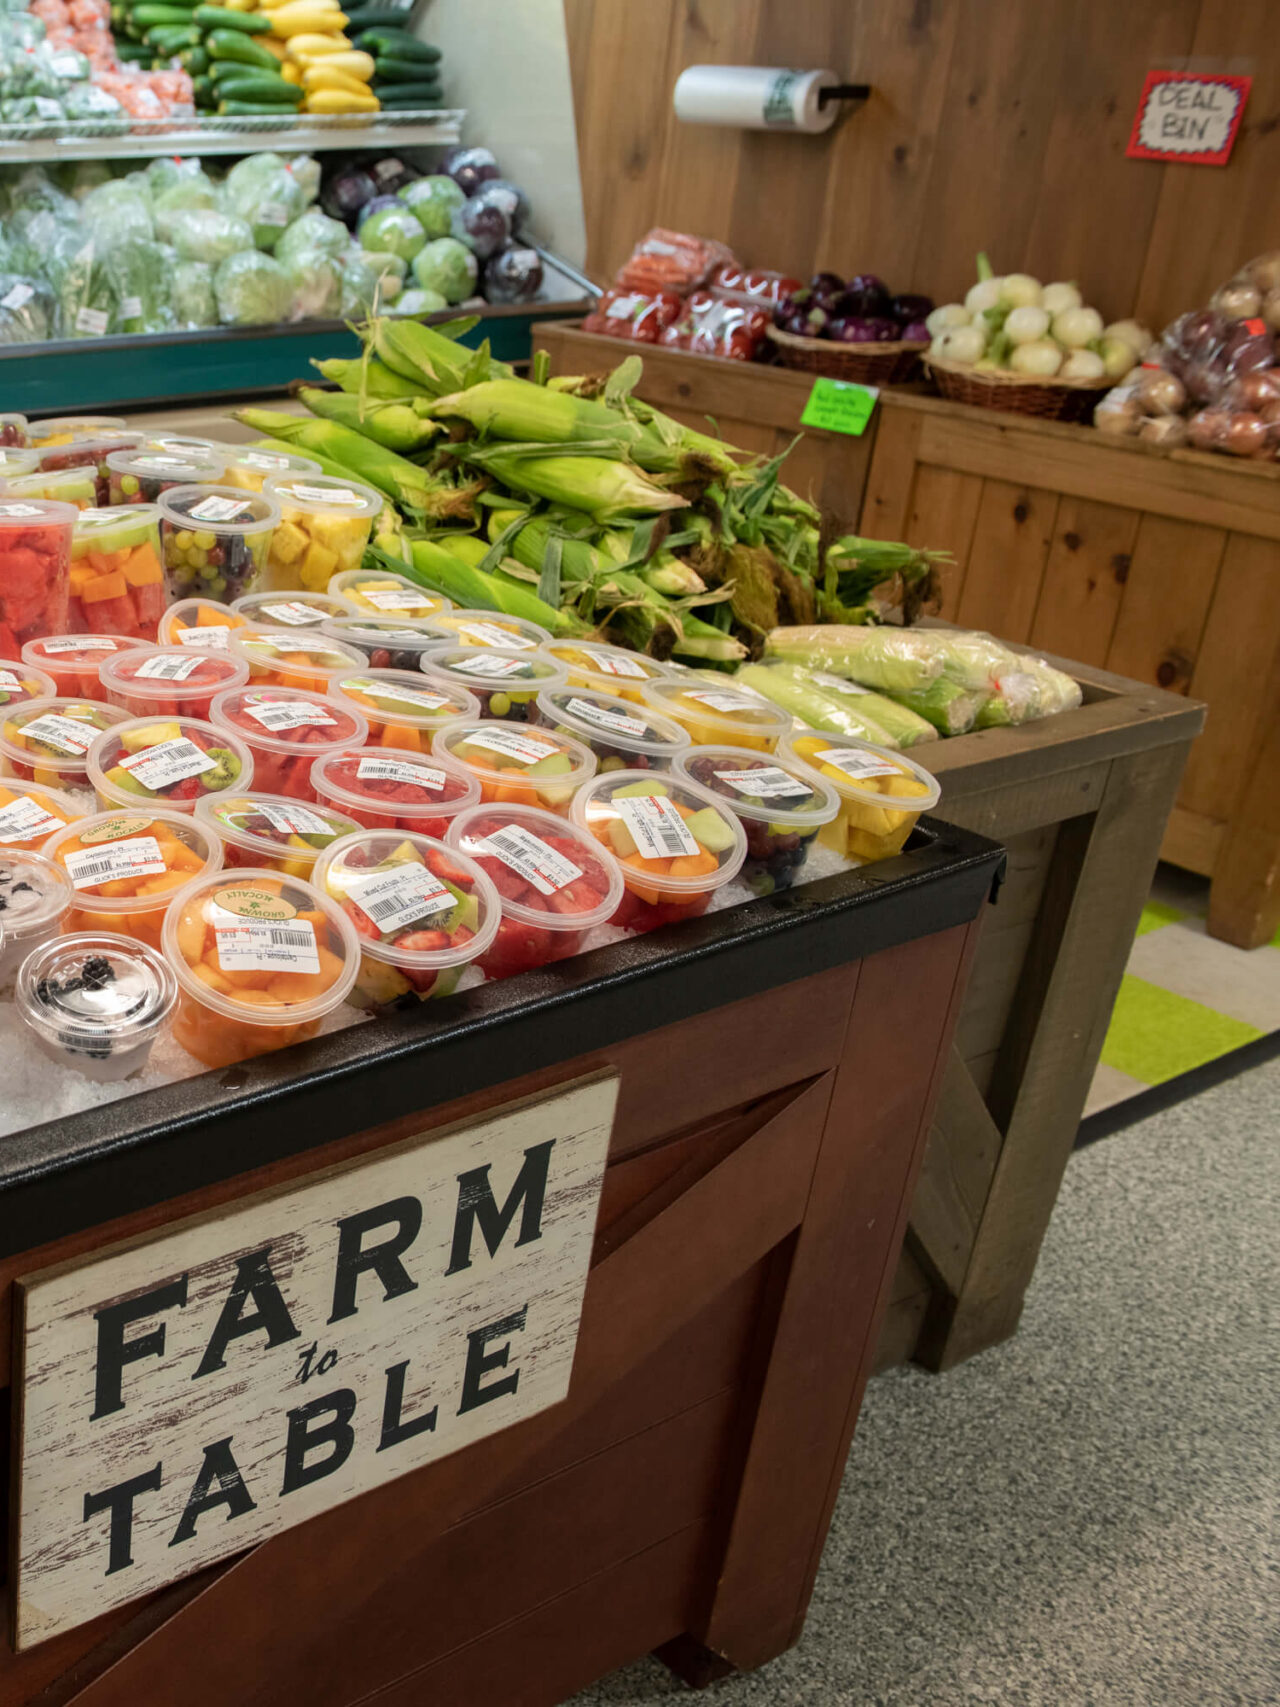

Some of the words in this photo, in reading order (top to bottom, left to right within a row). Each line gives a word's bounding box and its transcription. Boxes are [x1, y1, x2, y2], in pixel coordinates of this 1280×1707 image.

[1158, 86, 1222, 111] DEAL
[1161, 113, 1210, 140] BIN
[87, 819, 123, 837] GROWN
[114, 822, 145, 838] LOCALLY
[117, 867, 144, 878] PRODUCE
[226, 891, 267, 900] LOCALLY
[246, 908, 286, 918] GROWN
[413, 900, 442, 917] PRODUCE
[267, 952, 298, 962] Cantaloupe
[90, 1138, 557, 1422] FARM
[294, 1340, 338, 1385] to
[83, 1302, 529, 1576] TABLE
